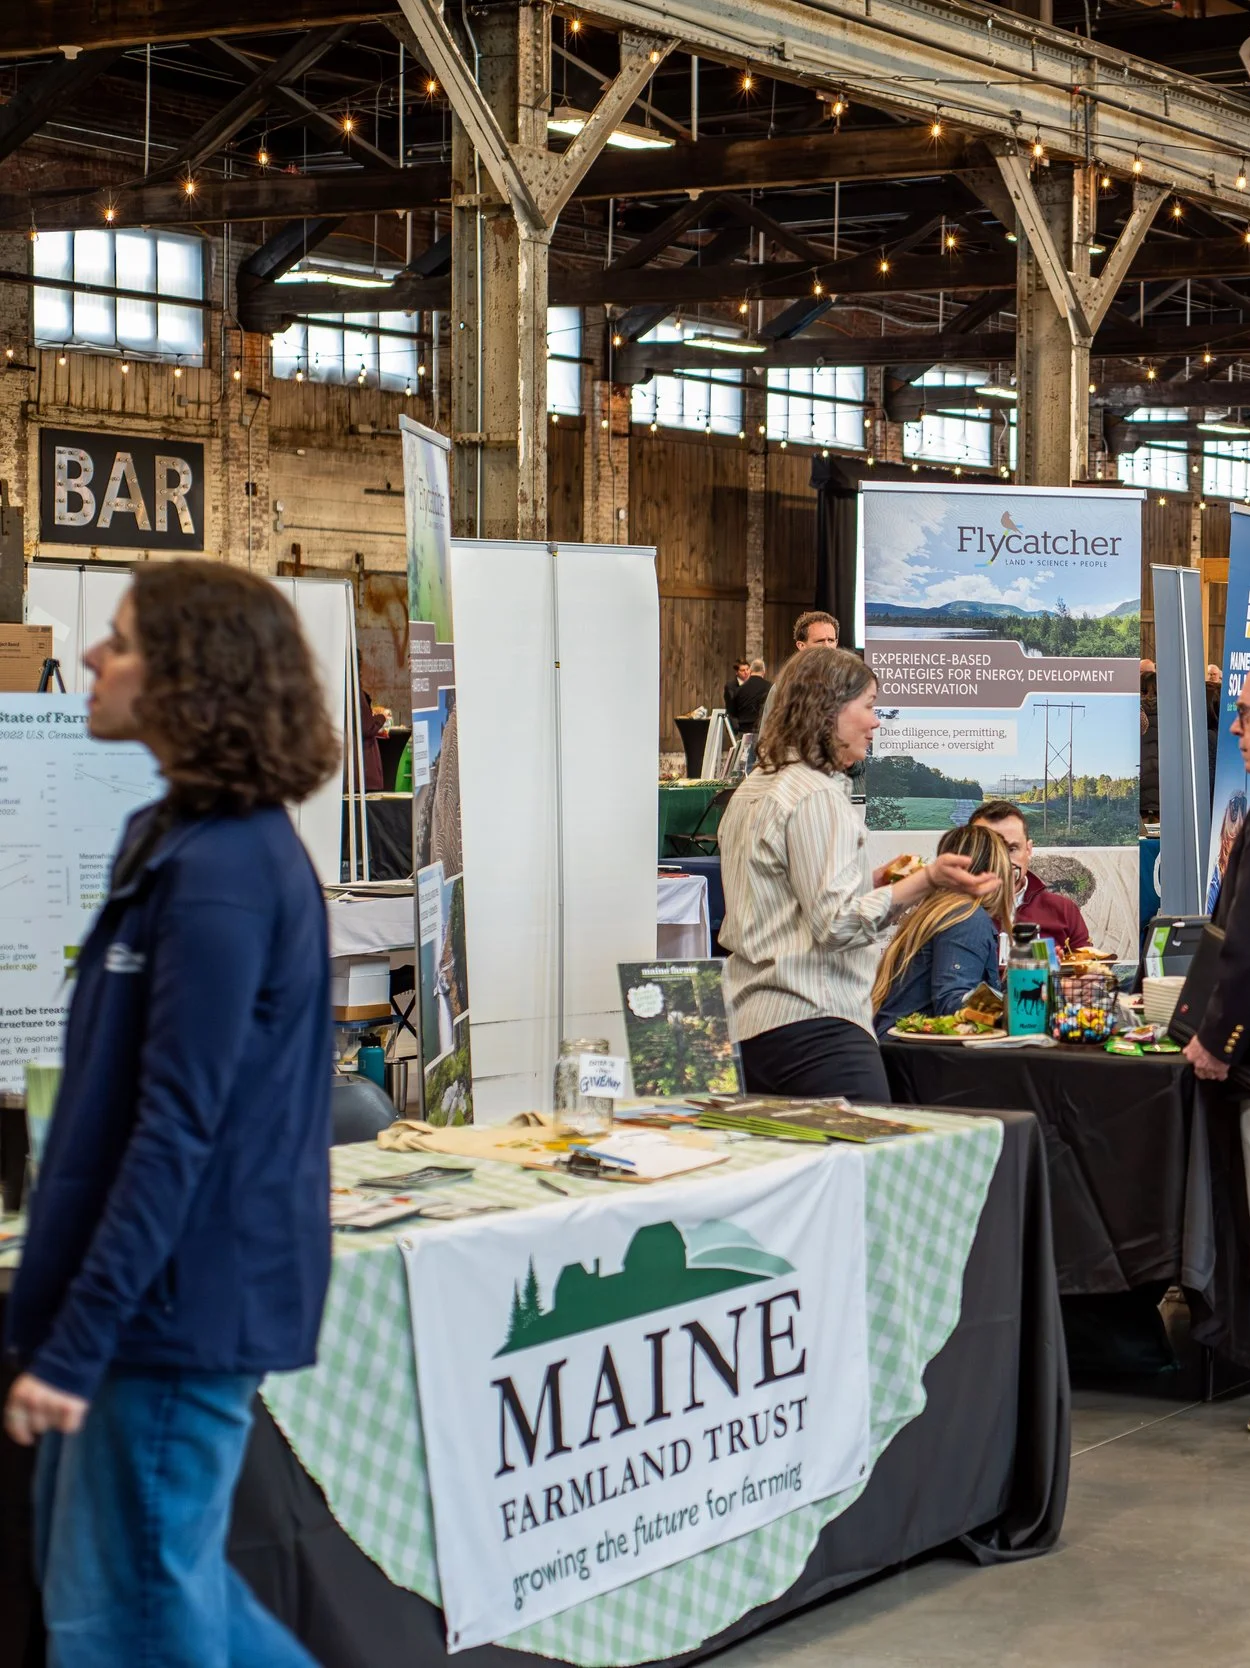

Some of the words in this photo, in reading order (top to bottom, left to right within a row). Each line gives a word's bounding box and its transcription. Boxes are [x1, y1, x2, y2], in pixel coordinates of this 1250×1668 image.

[55, 446, 195, 534] BAR
[957, 525, 1122, 566] Flycatcher
[1080, 560, 1107, 568] PEOPLE
[872, 652, 991, 666] EXPERIENCE-BASED
[872, 667, 943, 680] STRATEGIES
[948, 669, 971, 680] FOR
[975, 669, 1024, 683] ENERGY,
[1028, 670, 1115, 683] DEVELOPMENT
[882, 683, 978, 695] CONSERVATION
[36, 712, 51, 723] of
[26, 731, 45, 740] U.S.
[48, 731, 84, 740] Census
[879, 727, 901, 737] Due
[902, 727, 951, 740] diligence,
[953, 727, 1007, 741] permitting,
[879, 741, 939, 752] compliance
[947, 740, 994, 753] oversight
[6, 1007, 24, 1015] not
[25, 1006, 37, 1014] be
[24, 1034, 59, 1043] resonate
[31, 1045, 41, 1053] all
[489, 1289, 807, 1479] MAINE
[499, 1438, 692, 1541] FARMLAND
[703, 1396, 808, 1463] TRUST
[512, 1547, 587, 1610] growing
[596, 1530, 629, 1564] the
[631, 1501, 700, 1556] future
[704, 1488, 738, 1520] for
